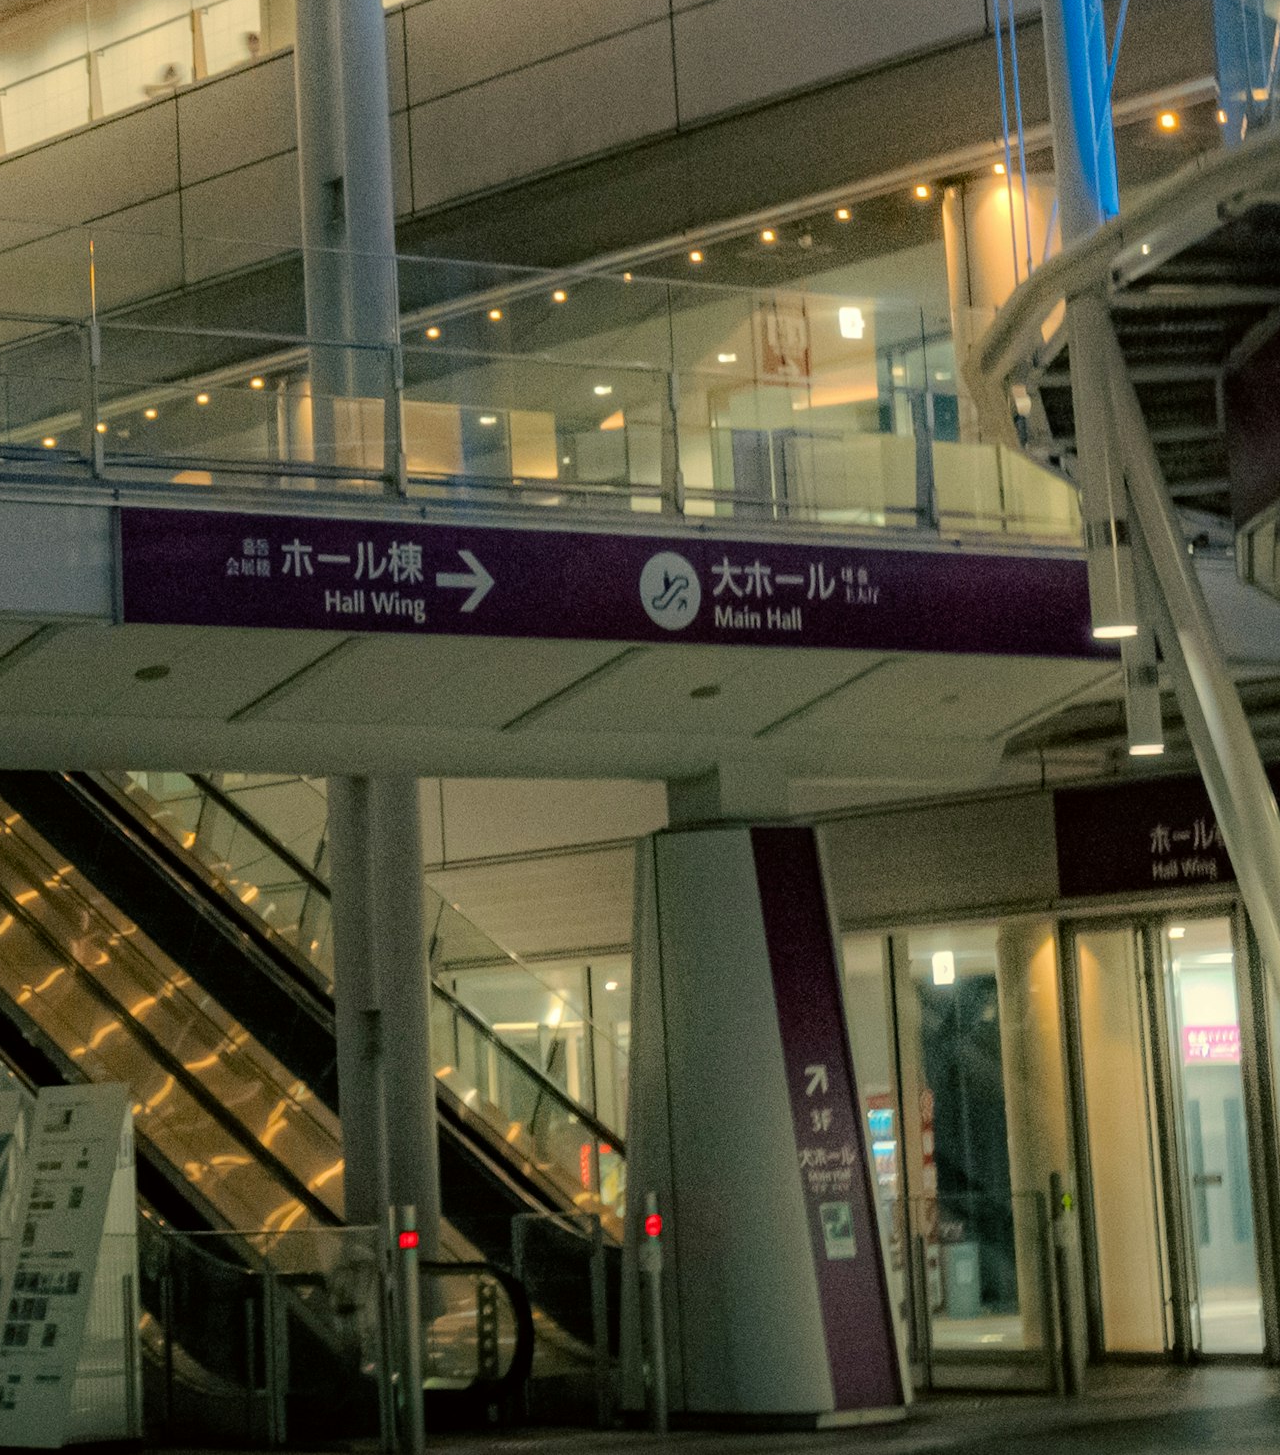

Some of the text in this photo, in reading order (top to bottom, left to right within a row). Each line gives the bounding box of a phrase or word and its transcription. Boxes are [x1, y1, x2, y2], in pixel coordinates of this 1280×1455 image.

[280, 538, 424, 584] ホール棟
[710, 555, 837, 601] 大ホール
[324, 589, 427, 625] Hall Wing
[714, 603, 803, 632] Main Hall
[1151, 856, 1219, 882] Hall Wing
